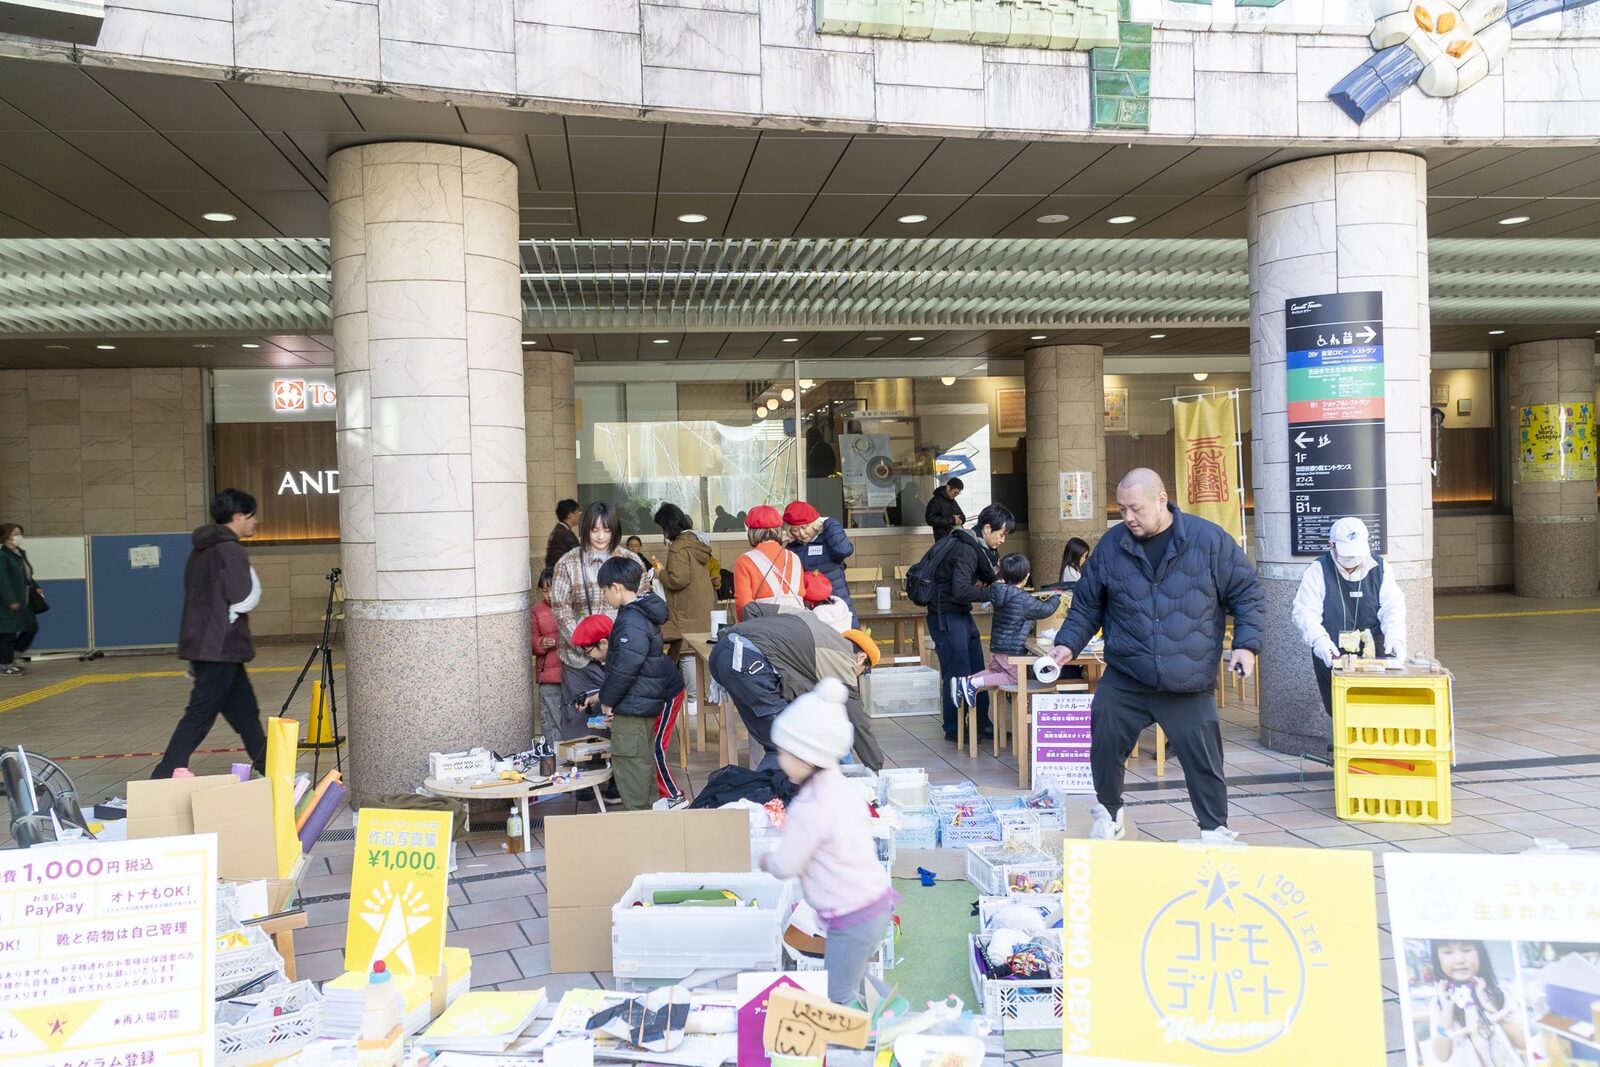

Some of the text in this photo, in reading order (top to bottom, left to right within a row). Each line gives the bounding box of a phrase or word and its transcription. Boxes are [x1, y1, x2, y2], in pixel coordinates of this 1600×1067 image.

[1295, 452, 1307, 463] 1F
[368, 850, 436, 871] ¥1,000
[0, 870, 17, 884] 費
[1275, 874, 1305, 905] 100
[25, 900, 84, 918] PayPay
[56, 921, 188, 947] 靴と荷物は自己管理
[1174, 919, 1270, 967] コドモ
[1166, 966, 1286, 1017] デパート
[1068, 976, 1092, 1053] DEPA
